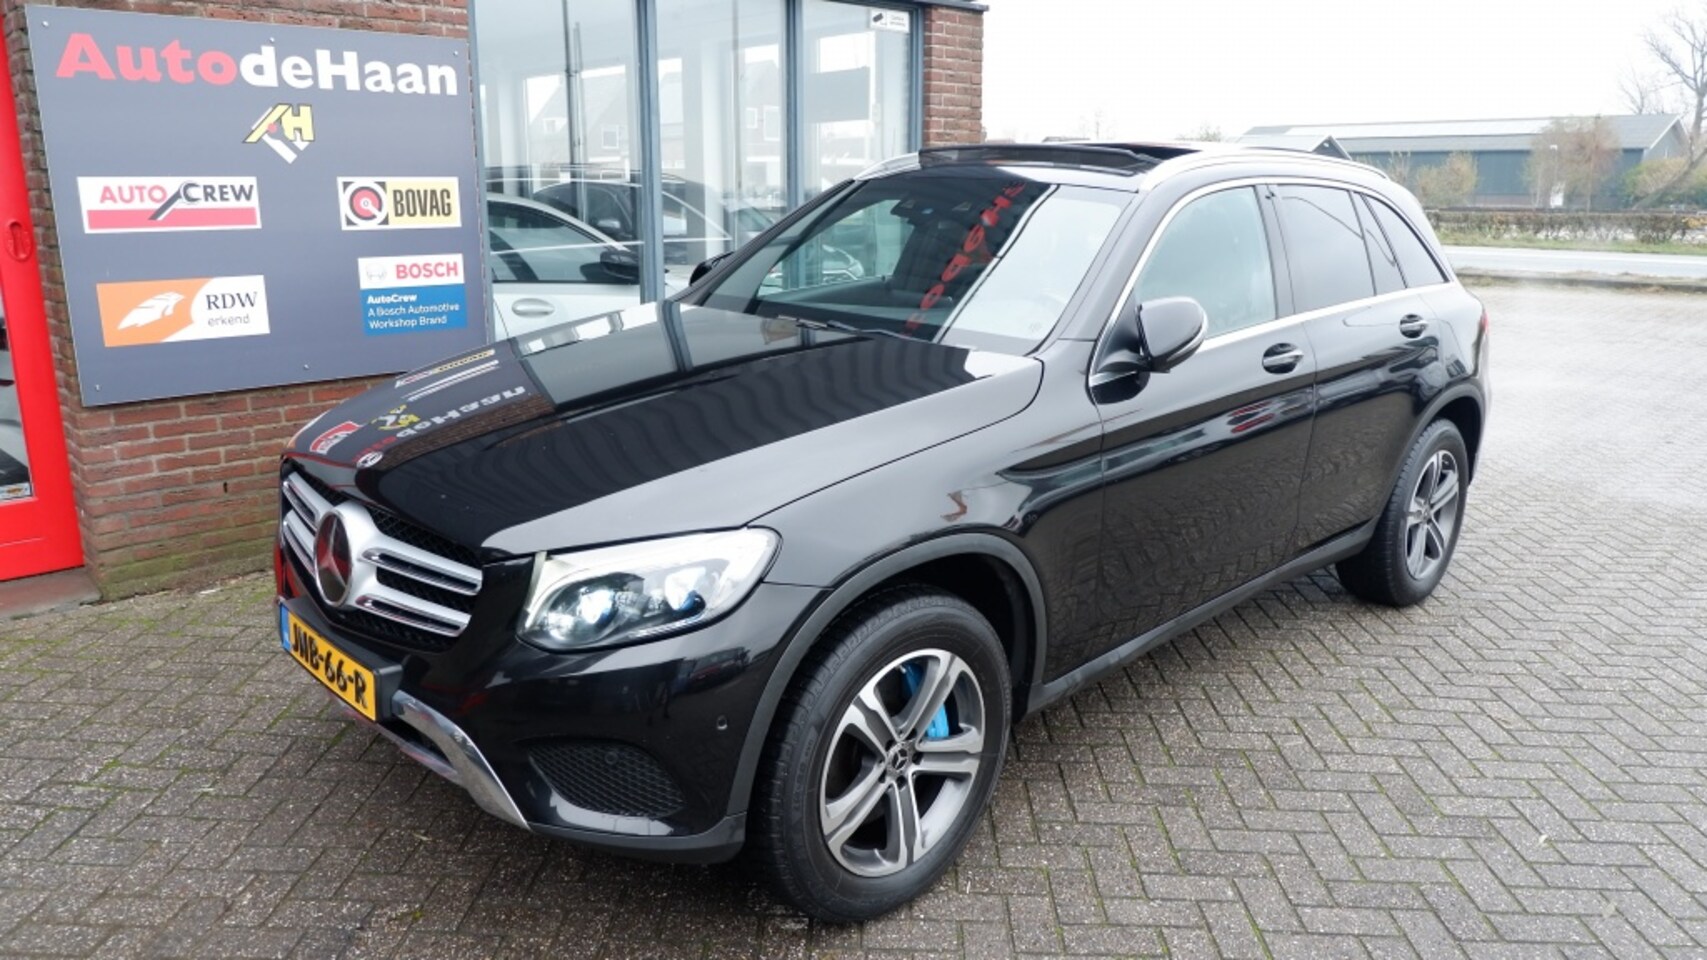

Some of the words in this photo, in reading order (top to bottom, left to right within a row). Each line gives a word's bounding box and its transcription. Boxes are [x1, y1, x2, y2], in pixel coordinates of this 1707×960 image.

[100, 184, 168, 204] AUTO
[181, 182, 255, 204] CREW
[392, 188, 453, 217] BOVAG
[395, 261, 459, 280] BOSCH
[205, 291, 258, 311] RDW
[366, 293, 418, 305] AutoCrew
[367, 307, 376, 318] A
[376, 306, 407, 317] Bosch
[407, 303, 461, 315] Automotive
[207, 314, 251, 327] erkend
[368, 319, 418, 330] Workshop
[418, 315, 448, 327] Brand
